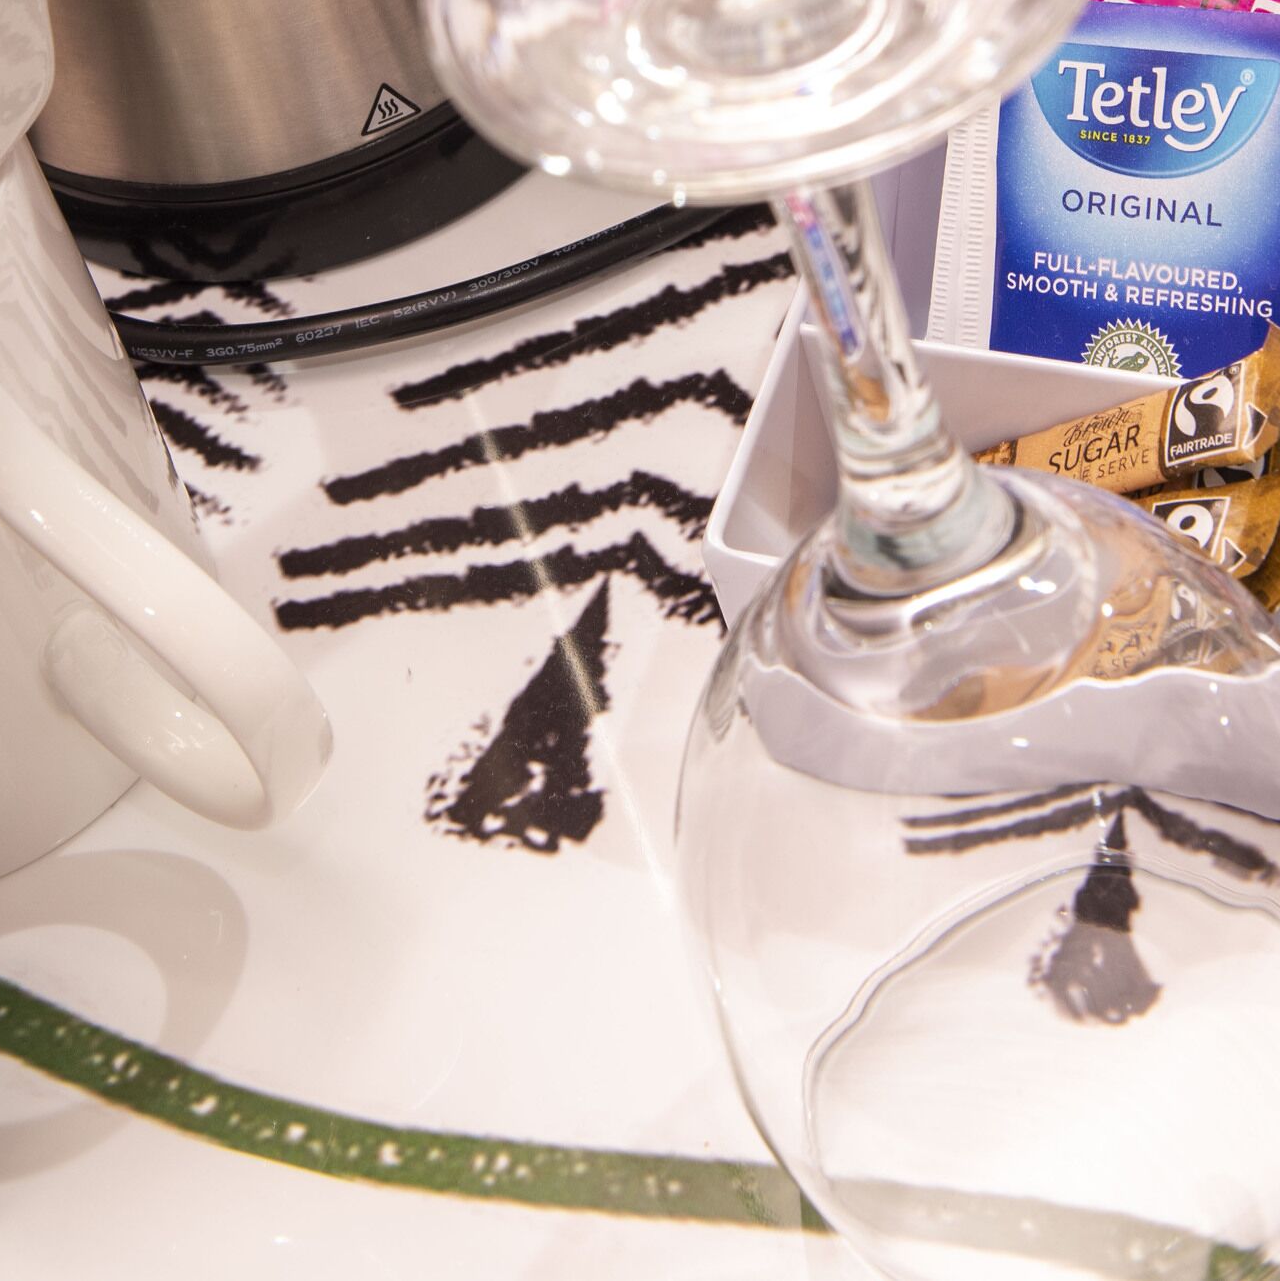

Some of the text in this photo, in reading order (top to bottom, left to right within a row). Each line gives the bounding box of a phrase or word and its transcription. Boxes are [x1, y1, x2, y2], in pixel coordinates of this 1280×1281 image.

[1058, 59, 1247, 153] Tetley
[1079, 129, 1152, 146] SINCE 1837
[1061, 189, 1223, 228] ORIGINAL
[467, 258, 541, 293] 300/300V
[1034, 251, 1243, 295] FULL-FLAVOURED,
[1007, 272, 1274, 318] SMOOTH & REFRESHING
[1094, 333, 1167, 375] INFOREST ALLIAN
[1048, 424, 1141, 475] SUGAR
[1097, 449, 1150, 479] SERVE
[1170, 432, 1233, 459] FAIRTRADE
